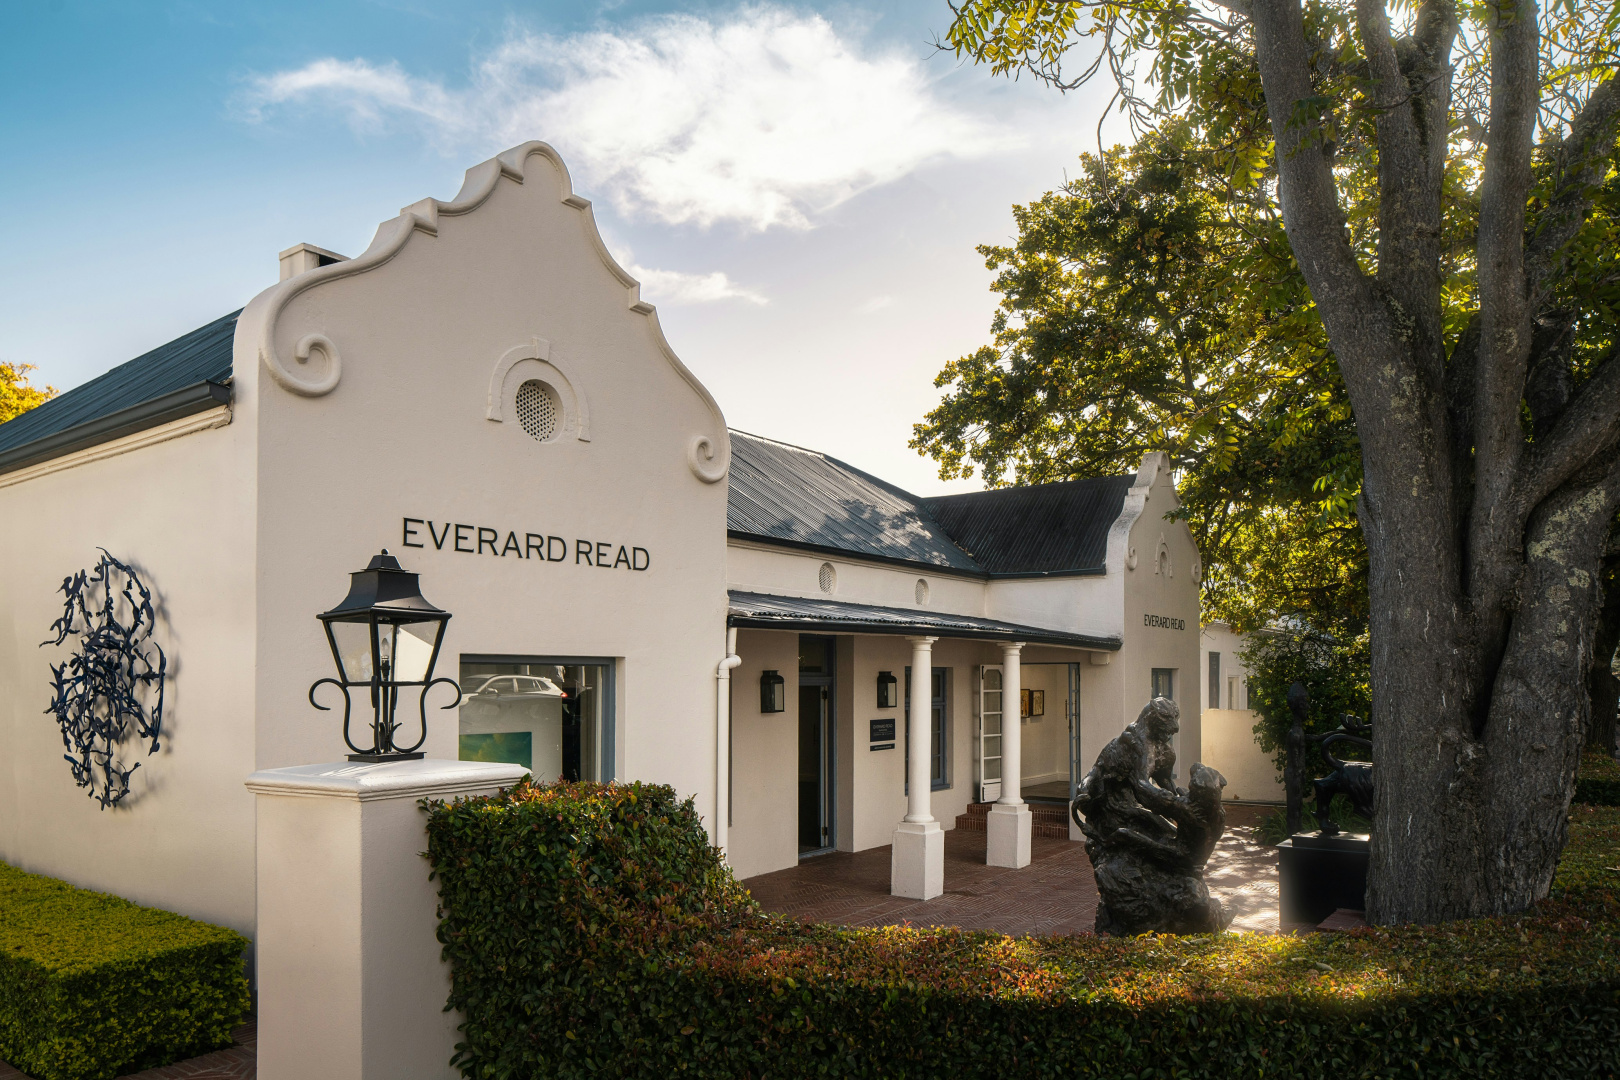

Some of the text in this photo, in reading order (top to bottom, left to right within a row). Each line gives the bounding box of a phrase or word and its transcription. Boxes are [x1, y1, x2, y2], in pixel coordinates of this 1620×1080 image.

[402, 517, 650, 571] EVERARD READ
[1144, 614, 1185, 630] EVERARD READ
